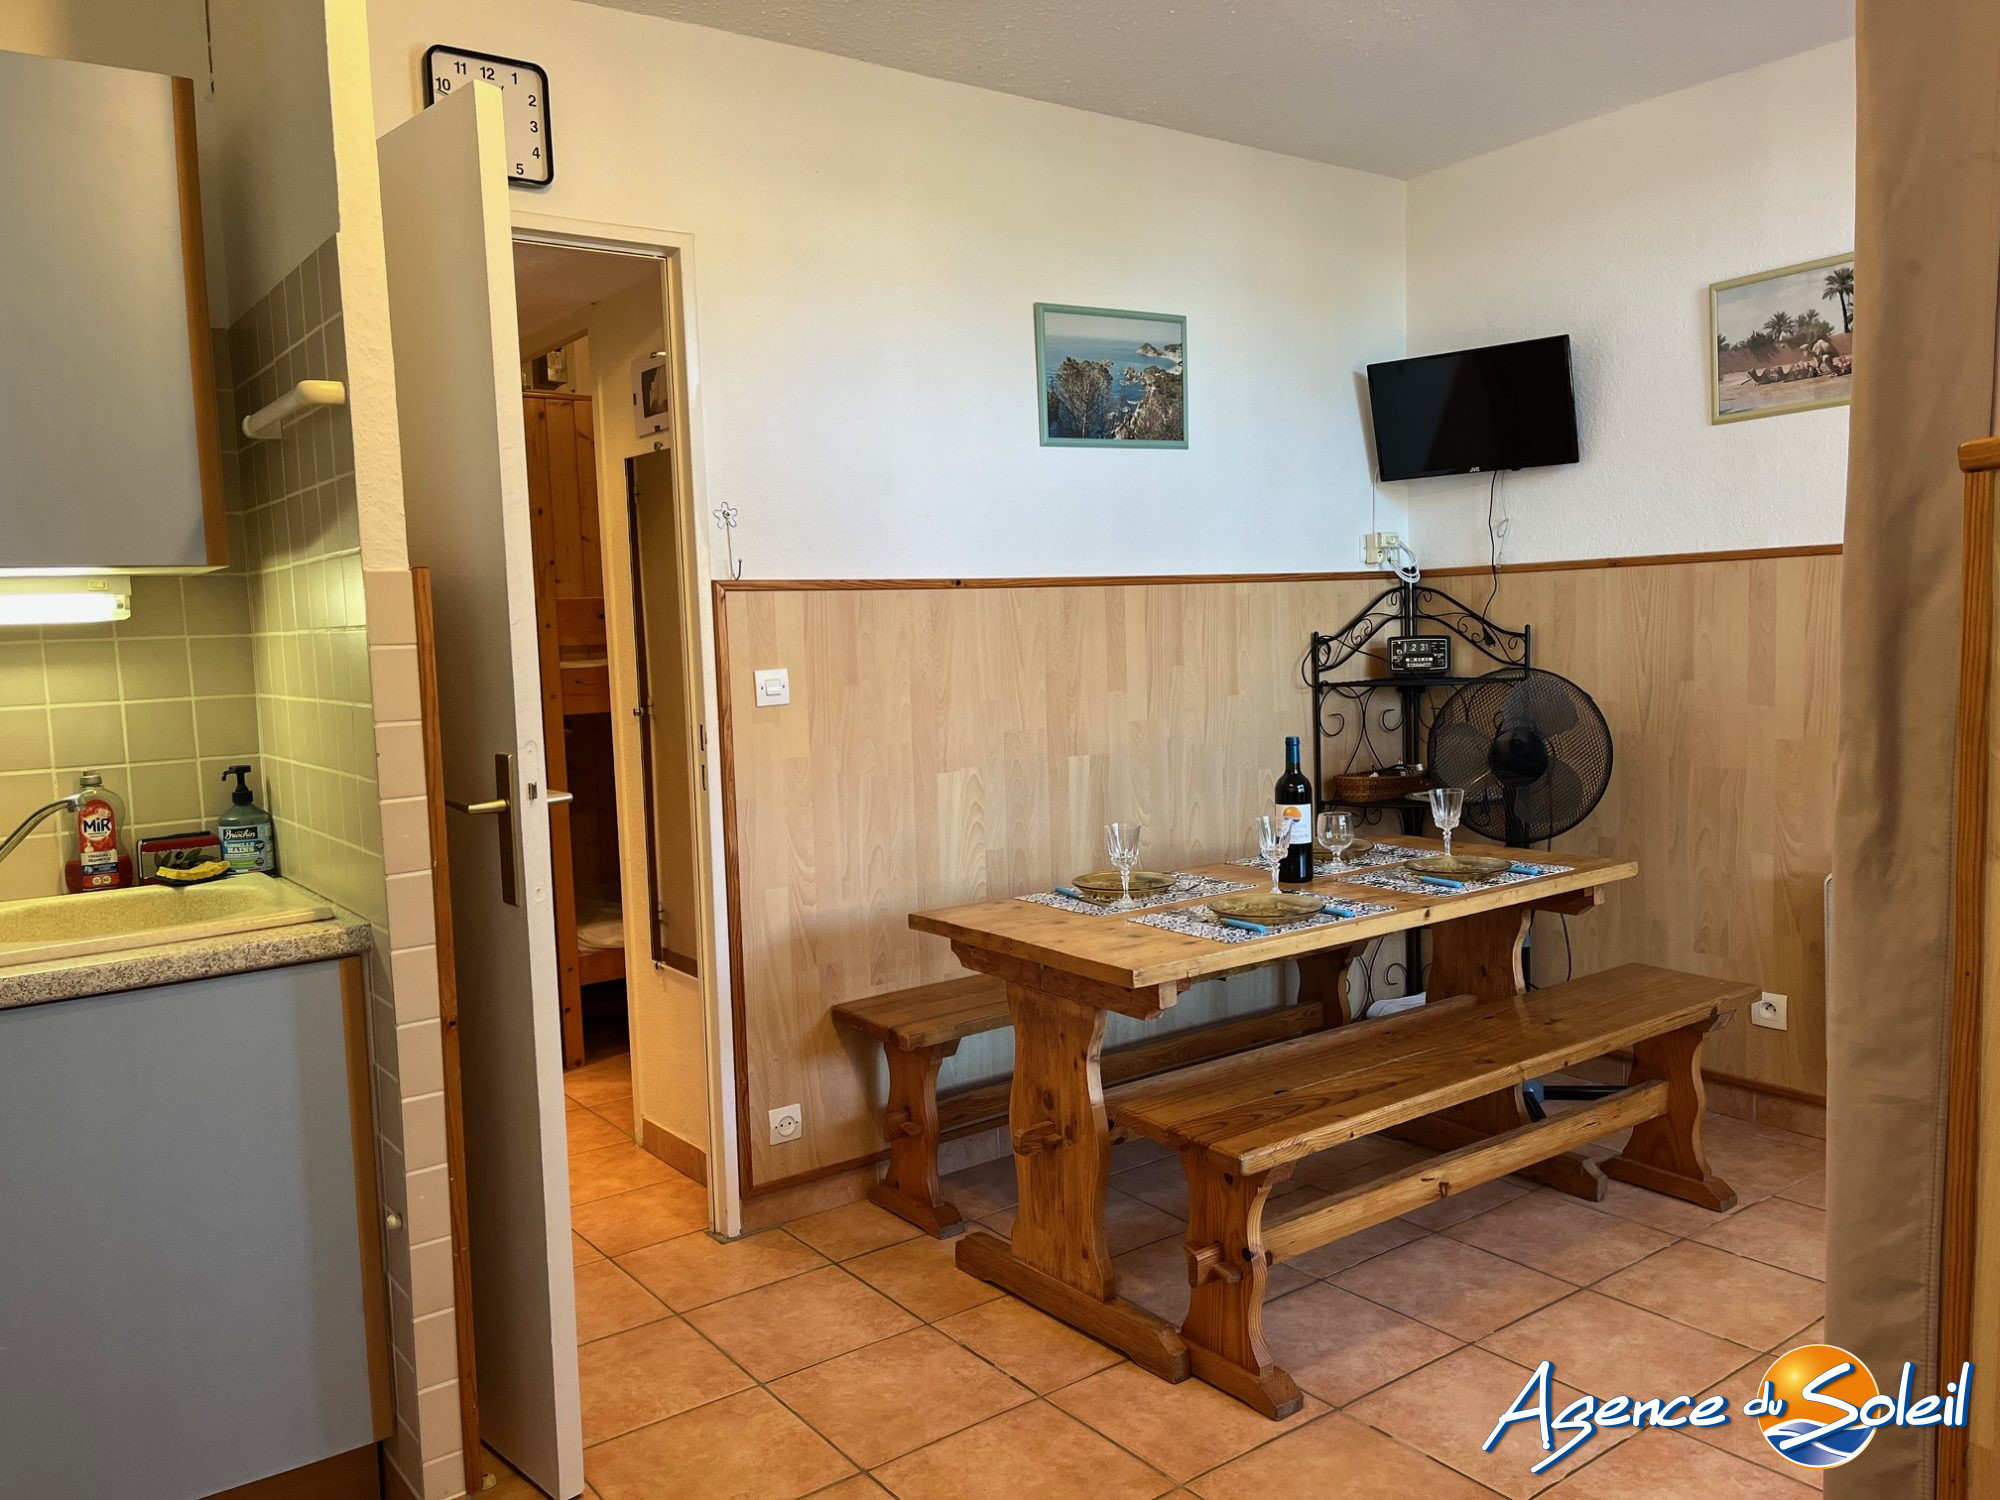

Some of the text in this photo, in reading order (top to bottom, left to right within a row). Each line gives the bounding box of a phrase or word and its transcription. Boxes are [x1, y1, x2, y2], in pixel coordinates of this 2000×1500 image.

[454, 61, 467, 75] 11
[480, 66, 495, 81] 12
[435, 77, 451, 91] 10
[511, 72, 518, 85] 1
[528, 94, 537, 107] 2
[530, 120, 539, 133] 3
[532, 147, 541, 160] 4
[516, 163, 524, 175] 5
[83, 817, 111, 833] MiR
